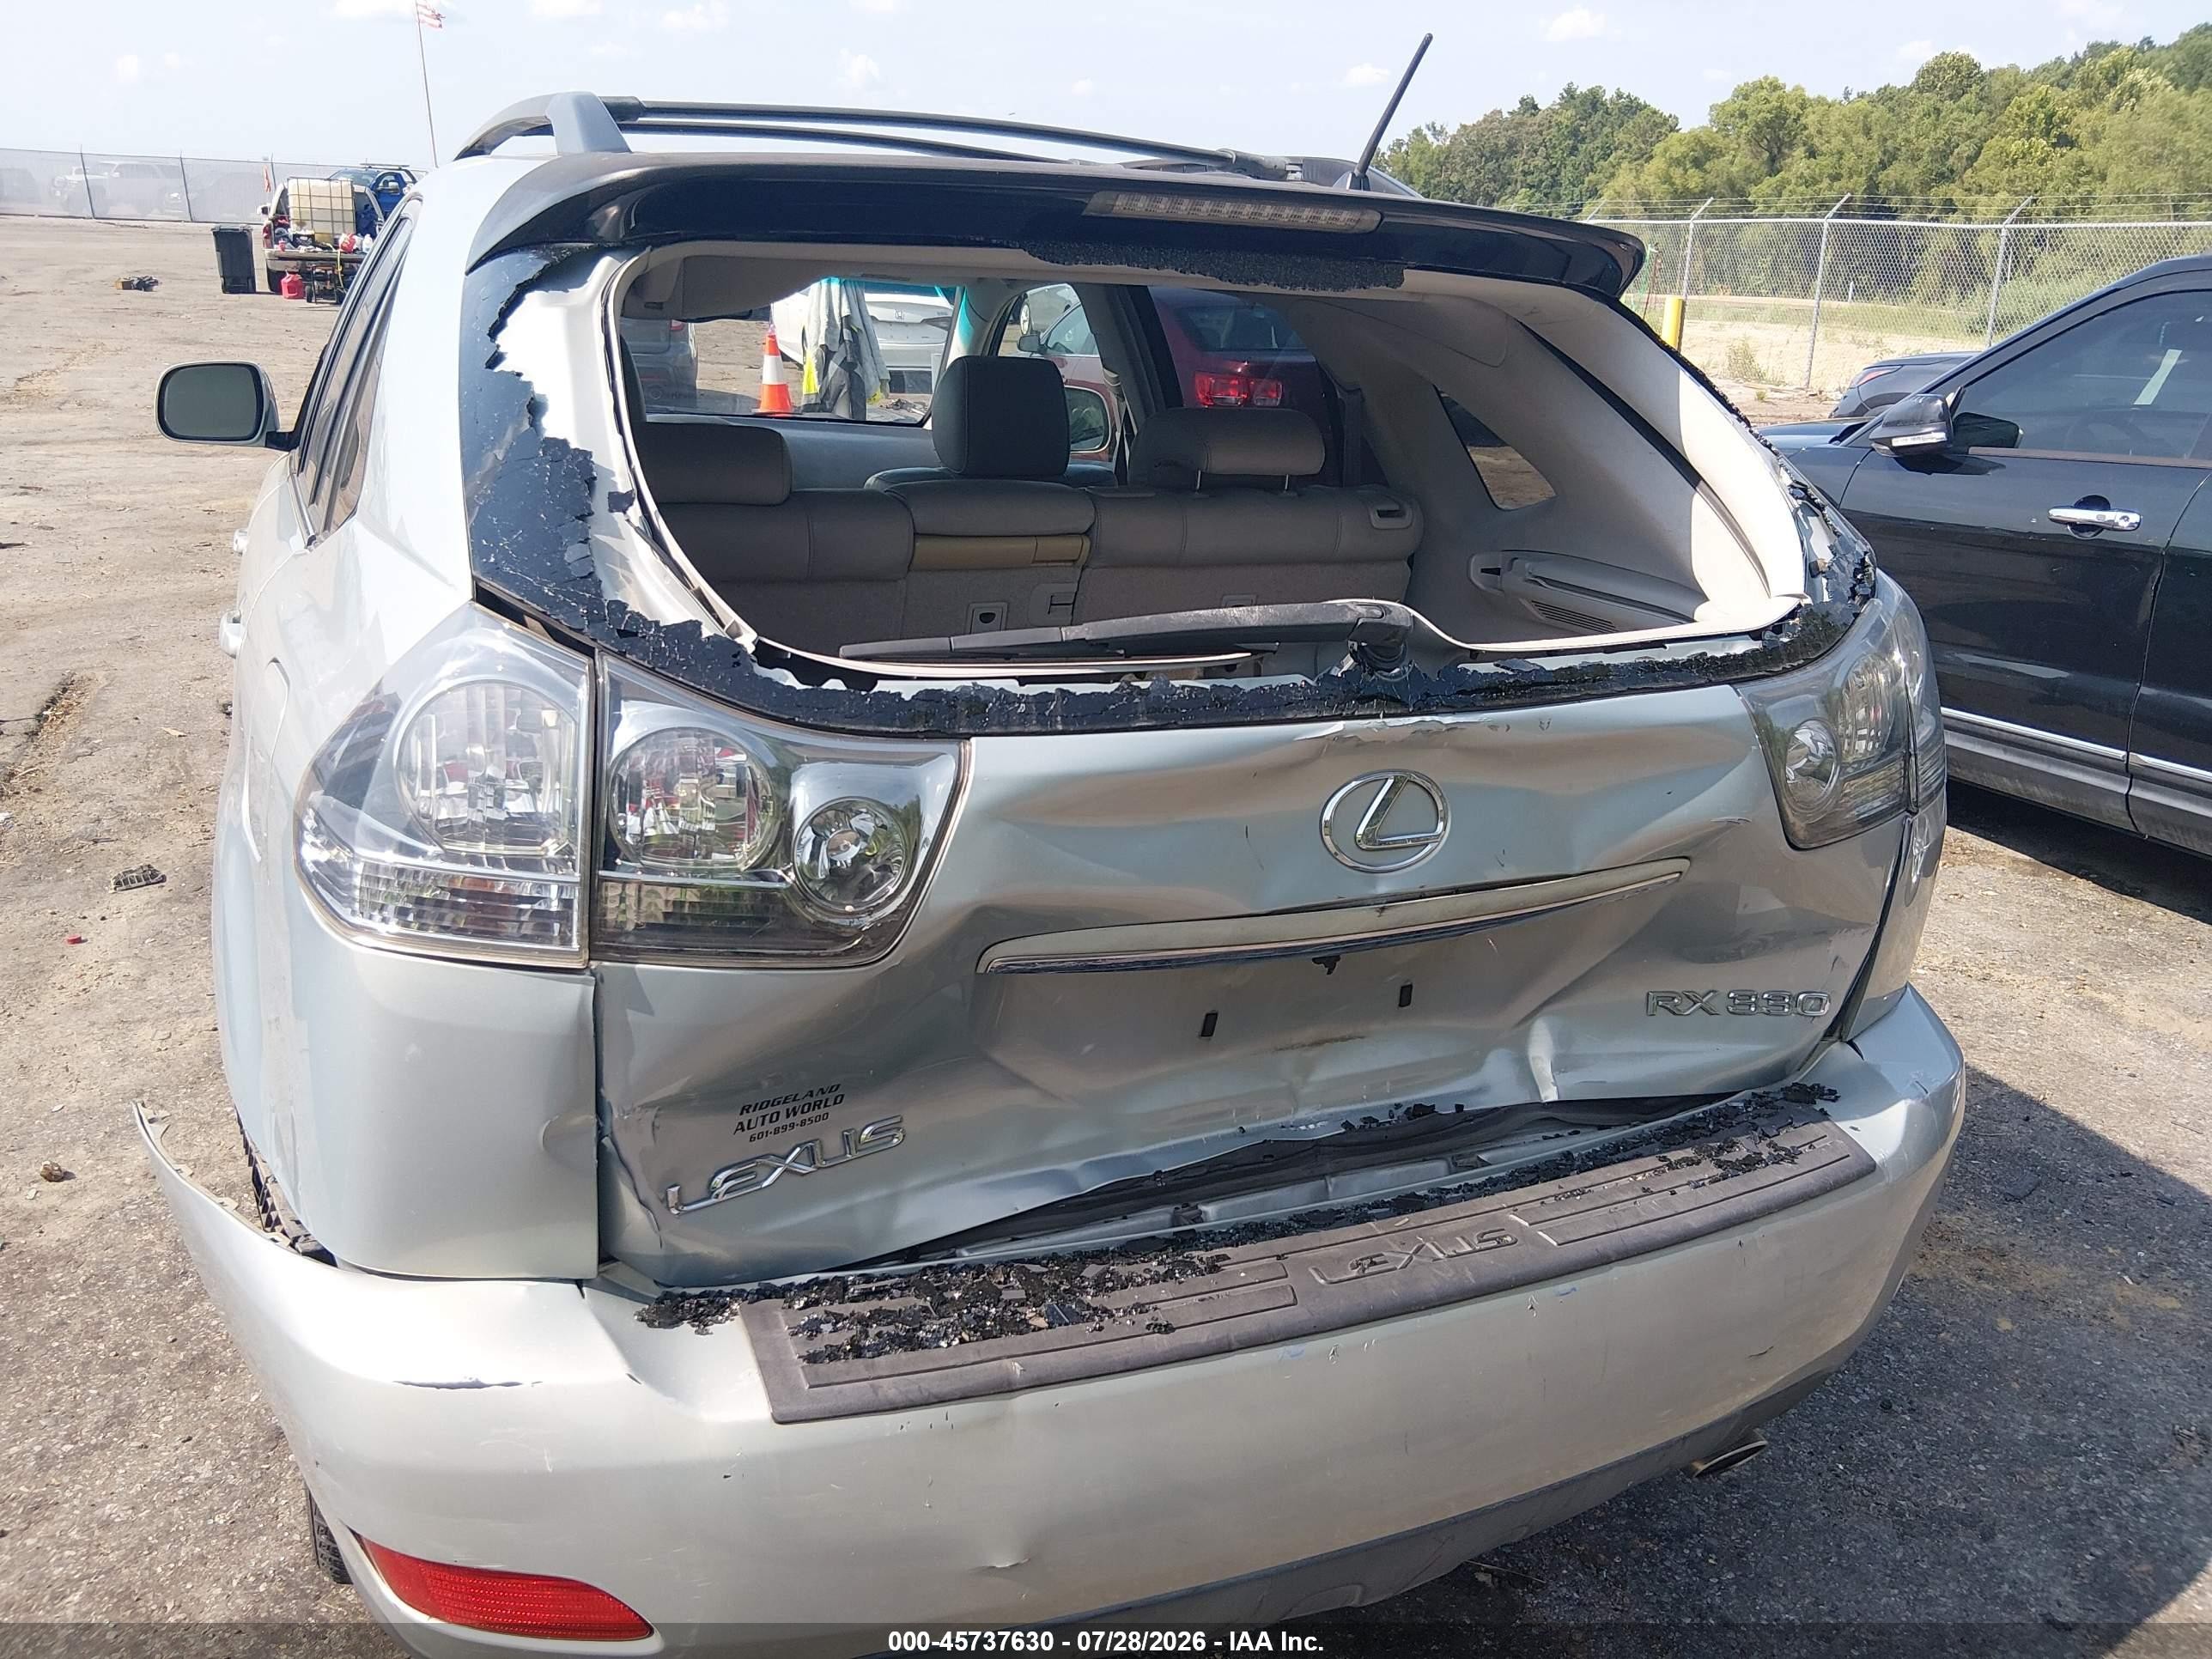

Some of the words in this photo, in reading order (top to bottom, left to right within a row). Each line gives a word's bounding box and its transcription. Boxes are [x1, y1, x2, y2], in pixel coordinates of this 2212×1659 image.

[1646, 990, 1720, 1017] RX
[1726, 990, 1832, 1018] 330
[733, 1111, 781, 1135] AUTO
[786, 1093, 846, 1119] WORLD
[739, 1084, 842, 1115] RIDGELAND
[666, 1115, 906, 1215] LEXUS
[1308, 1227, 1518, 1285] LEXUS
